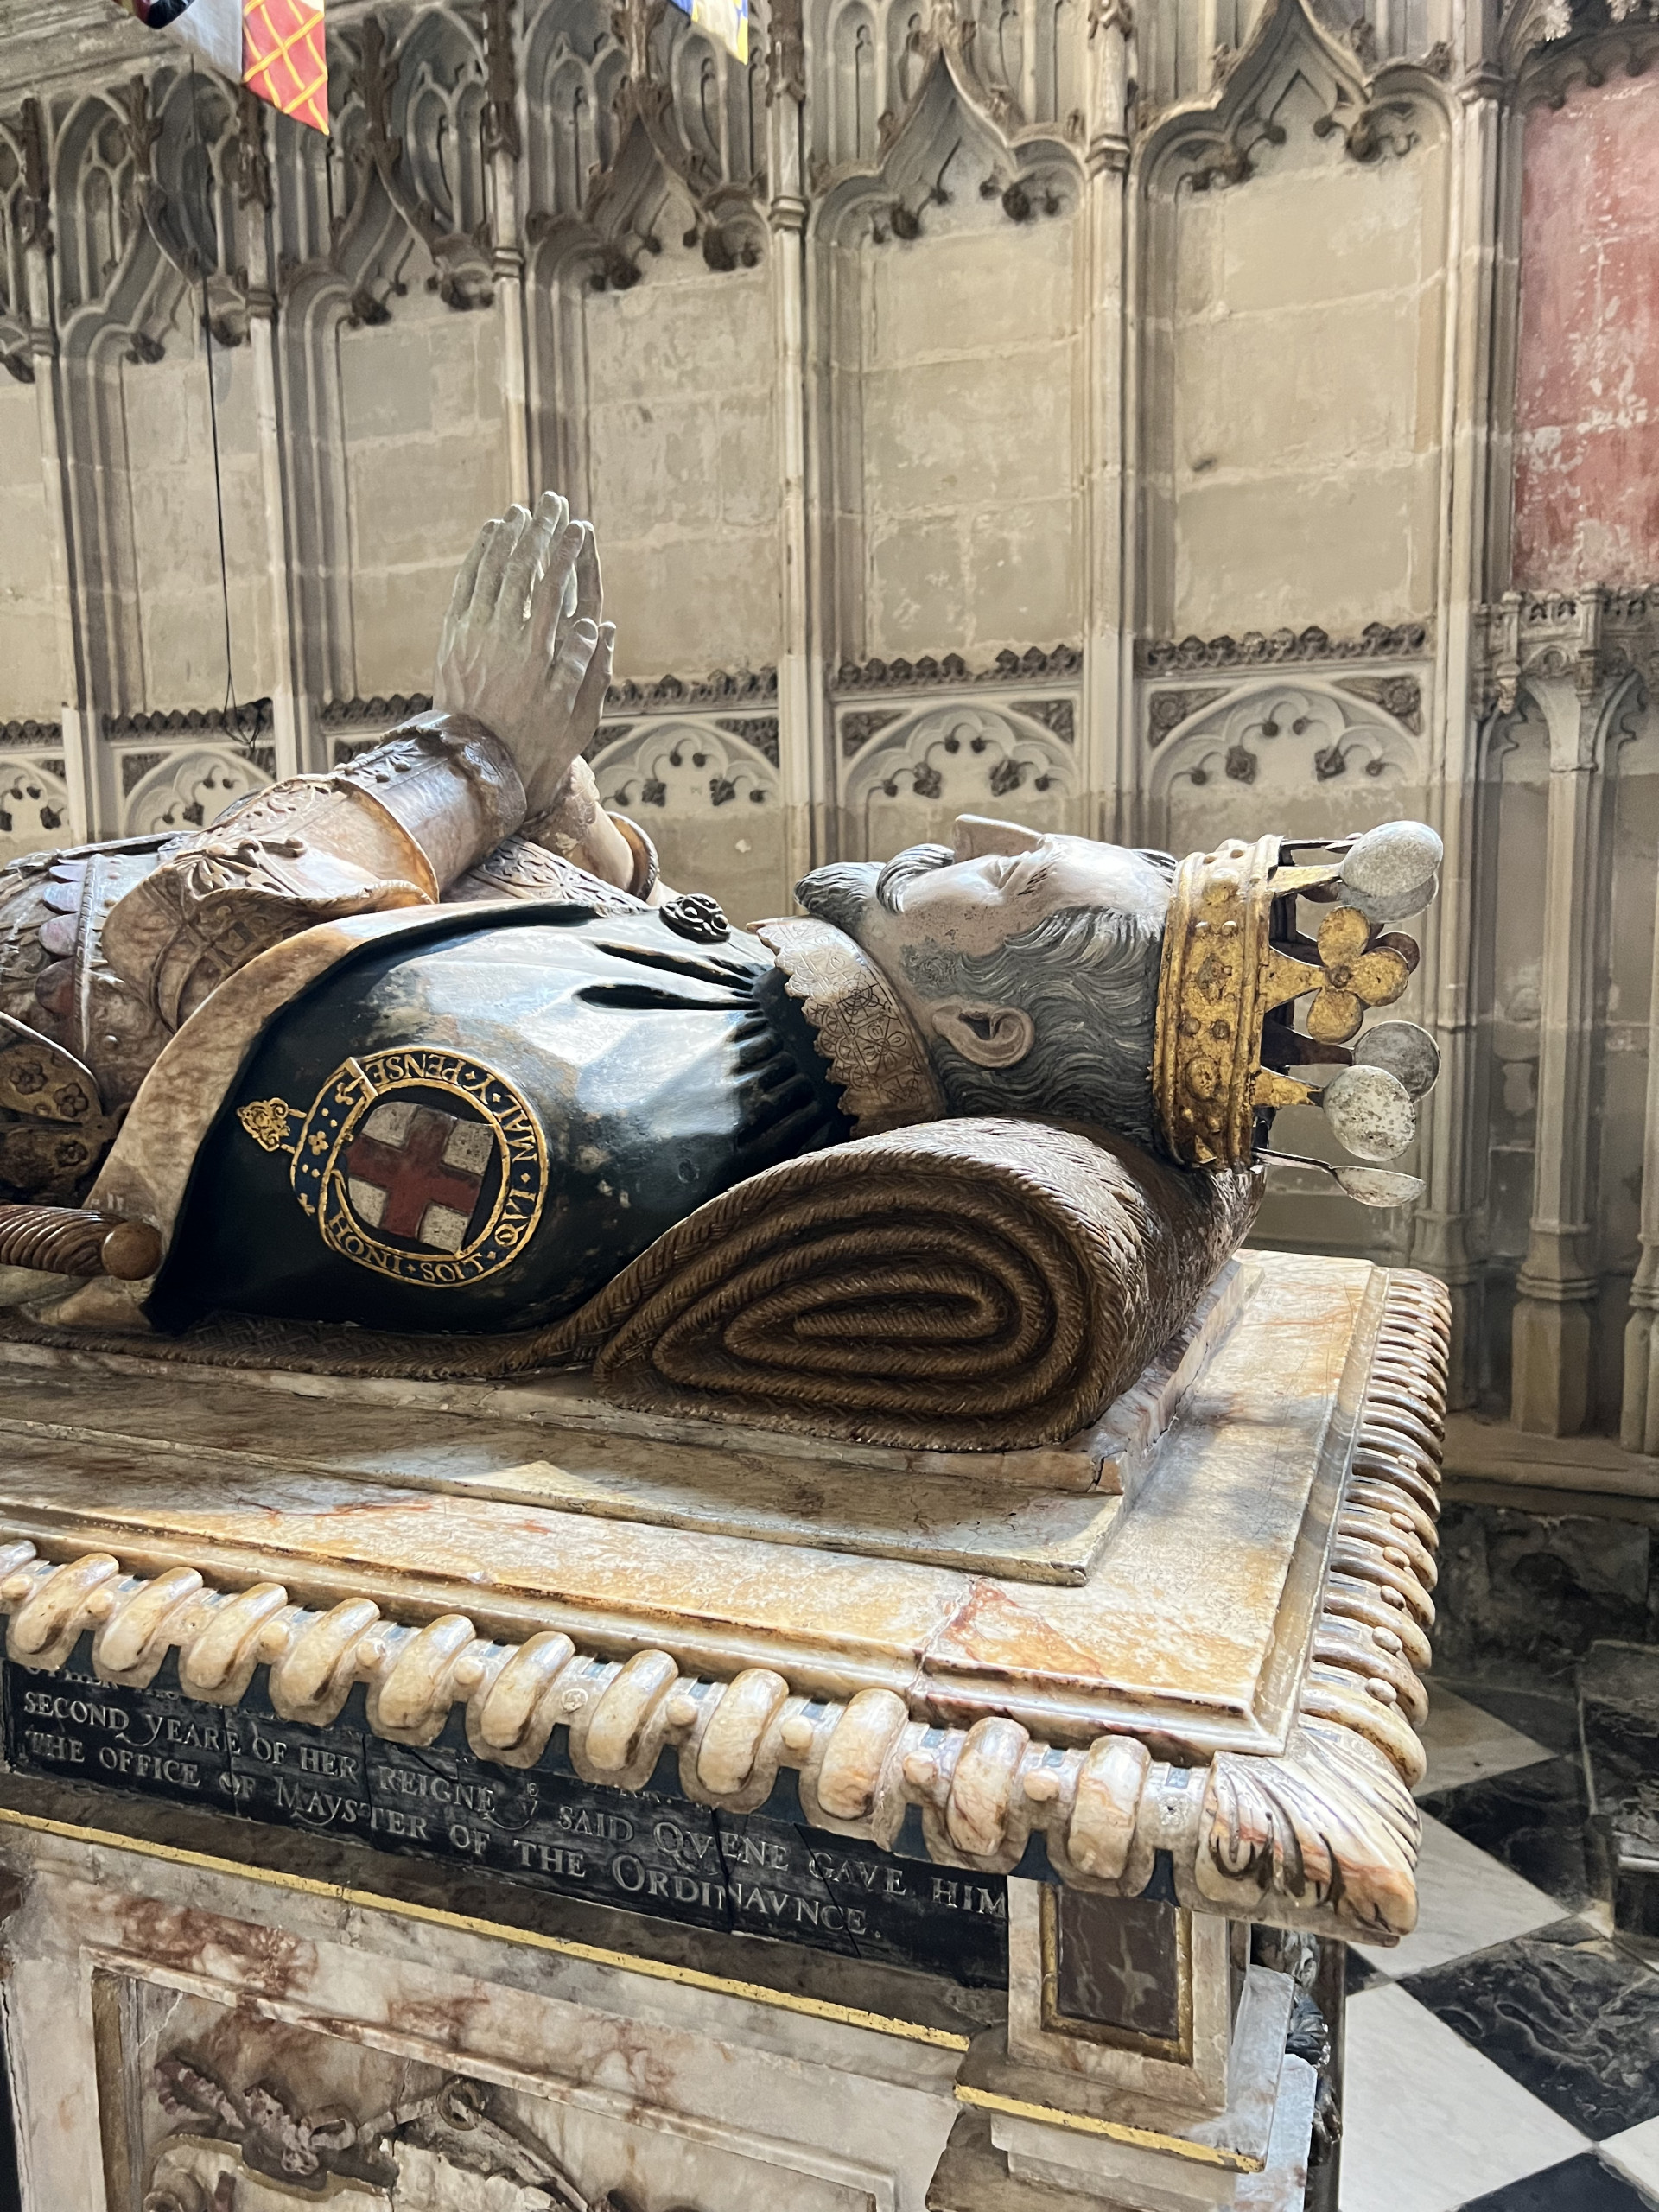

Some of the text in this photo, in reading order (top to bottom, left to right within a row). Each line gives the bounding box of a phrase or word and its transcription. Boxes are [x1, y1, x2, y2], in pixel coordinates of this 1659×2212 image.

[365, 1054, 467, 1082] PENSE
[463, 1073, 496, 1104] Y
[493, 1094, 537, 1162] MAL
[328, 1211, 402, 1274] HONI
[420, 1253, 484, 1281] SOIT
[24, 1691, 130, 1731] SECOND
[114, 1713, 242, 1756] YEARE
[252, 1738, 287, 1764] OF
[300, 1746, 359, 1783] HER
[378, 1765, 495, 1813] REIGNE
[560, 1806, 634, 1842] SAID
[653, 1822, 789, 1876] QVENE
[809, 1852, 906, 1896] GAVE
[931, 1877, 1007, 1918] HIM
[25, 1730, 85, 1763] THE
[99, 1746, 200, 1787] OFFICE
[219, 1771, 256, 1799] OF
[274, 1777, 431, 1840] MAYSTER
[449, 1824, 490, 1855] OF
[513, 1839, 586, 1878] THE
